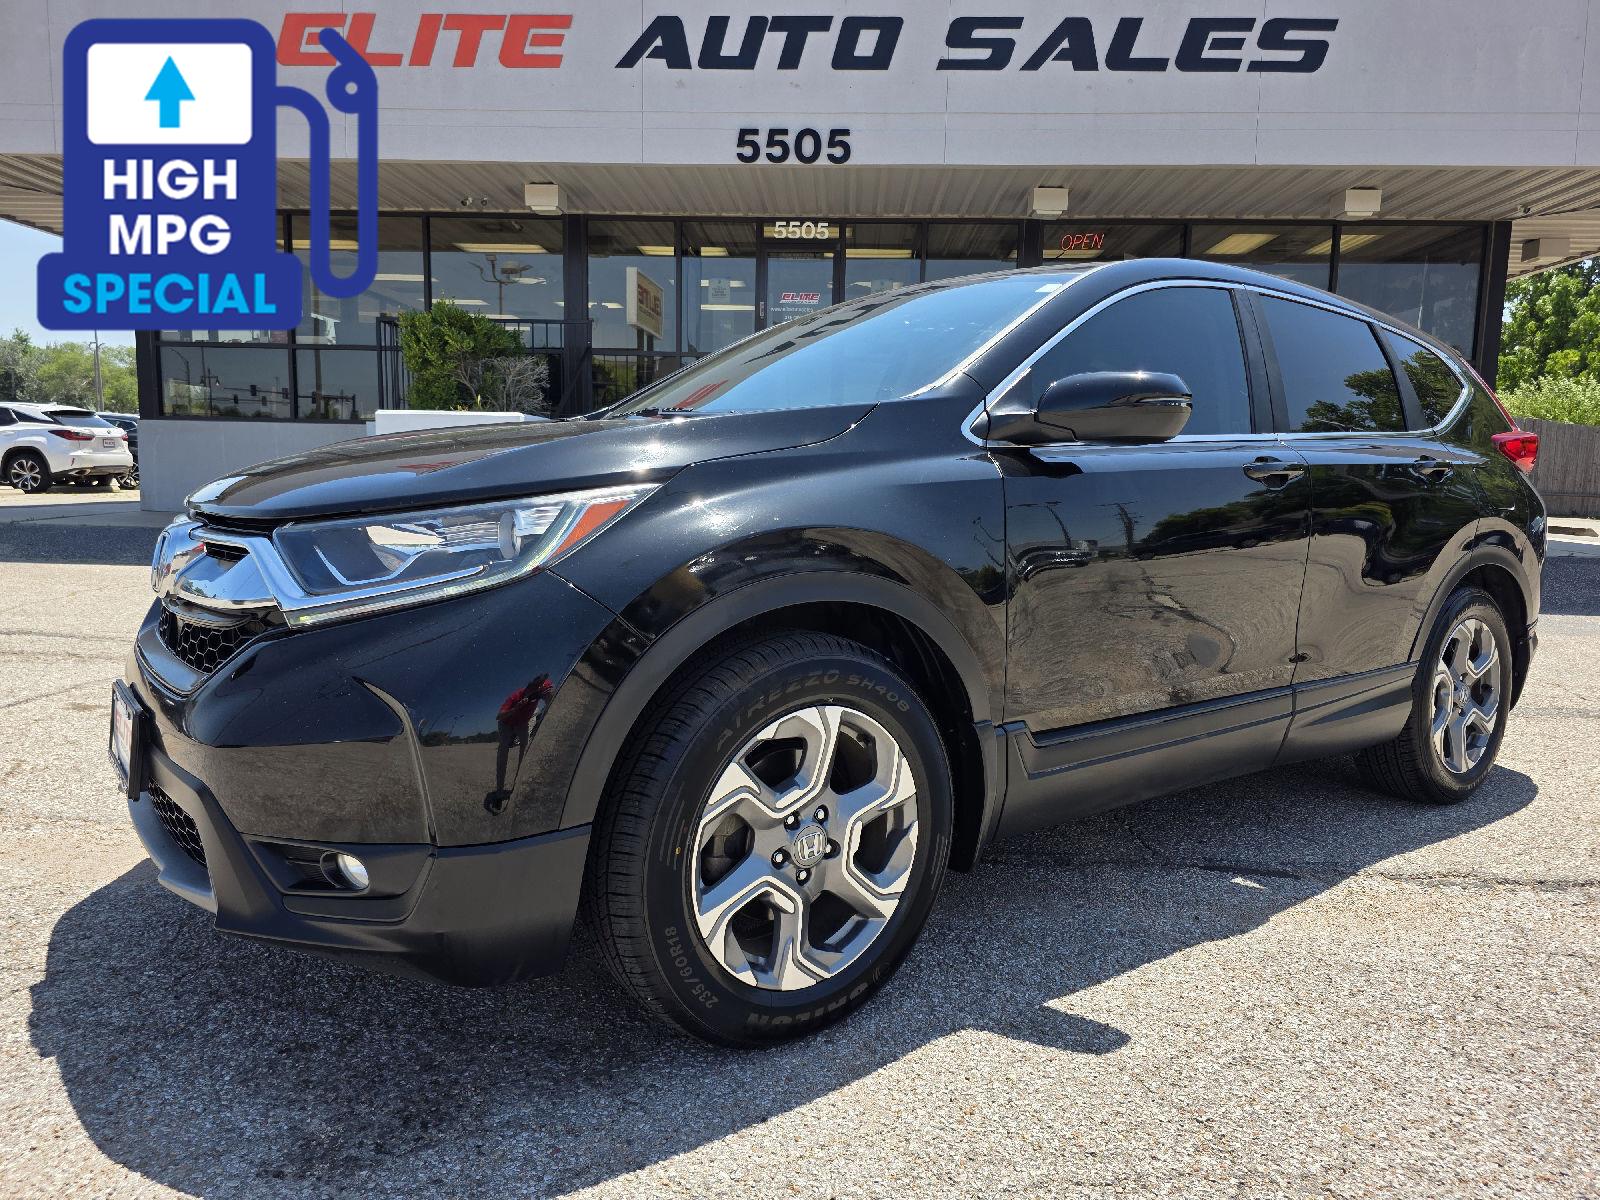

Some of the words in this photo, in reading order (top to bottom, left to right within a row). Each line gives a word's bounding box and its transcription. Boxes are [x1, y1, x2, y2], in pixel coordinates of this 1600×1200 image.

[276, 13, 572, 68] ELITE
[615, 15, 904, 71] AUTO
[936, 16, 1339, 73] SALES
[735, 128, 851, 165] 5505
[773, 221, 830, 240] 5505
[1061, 233, 1105, 251] OPEN
[781, 292, 821, 301] ELITE
[664, 925, 720, 1009] 235/60R18
